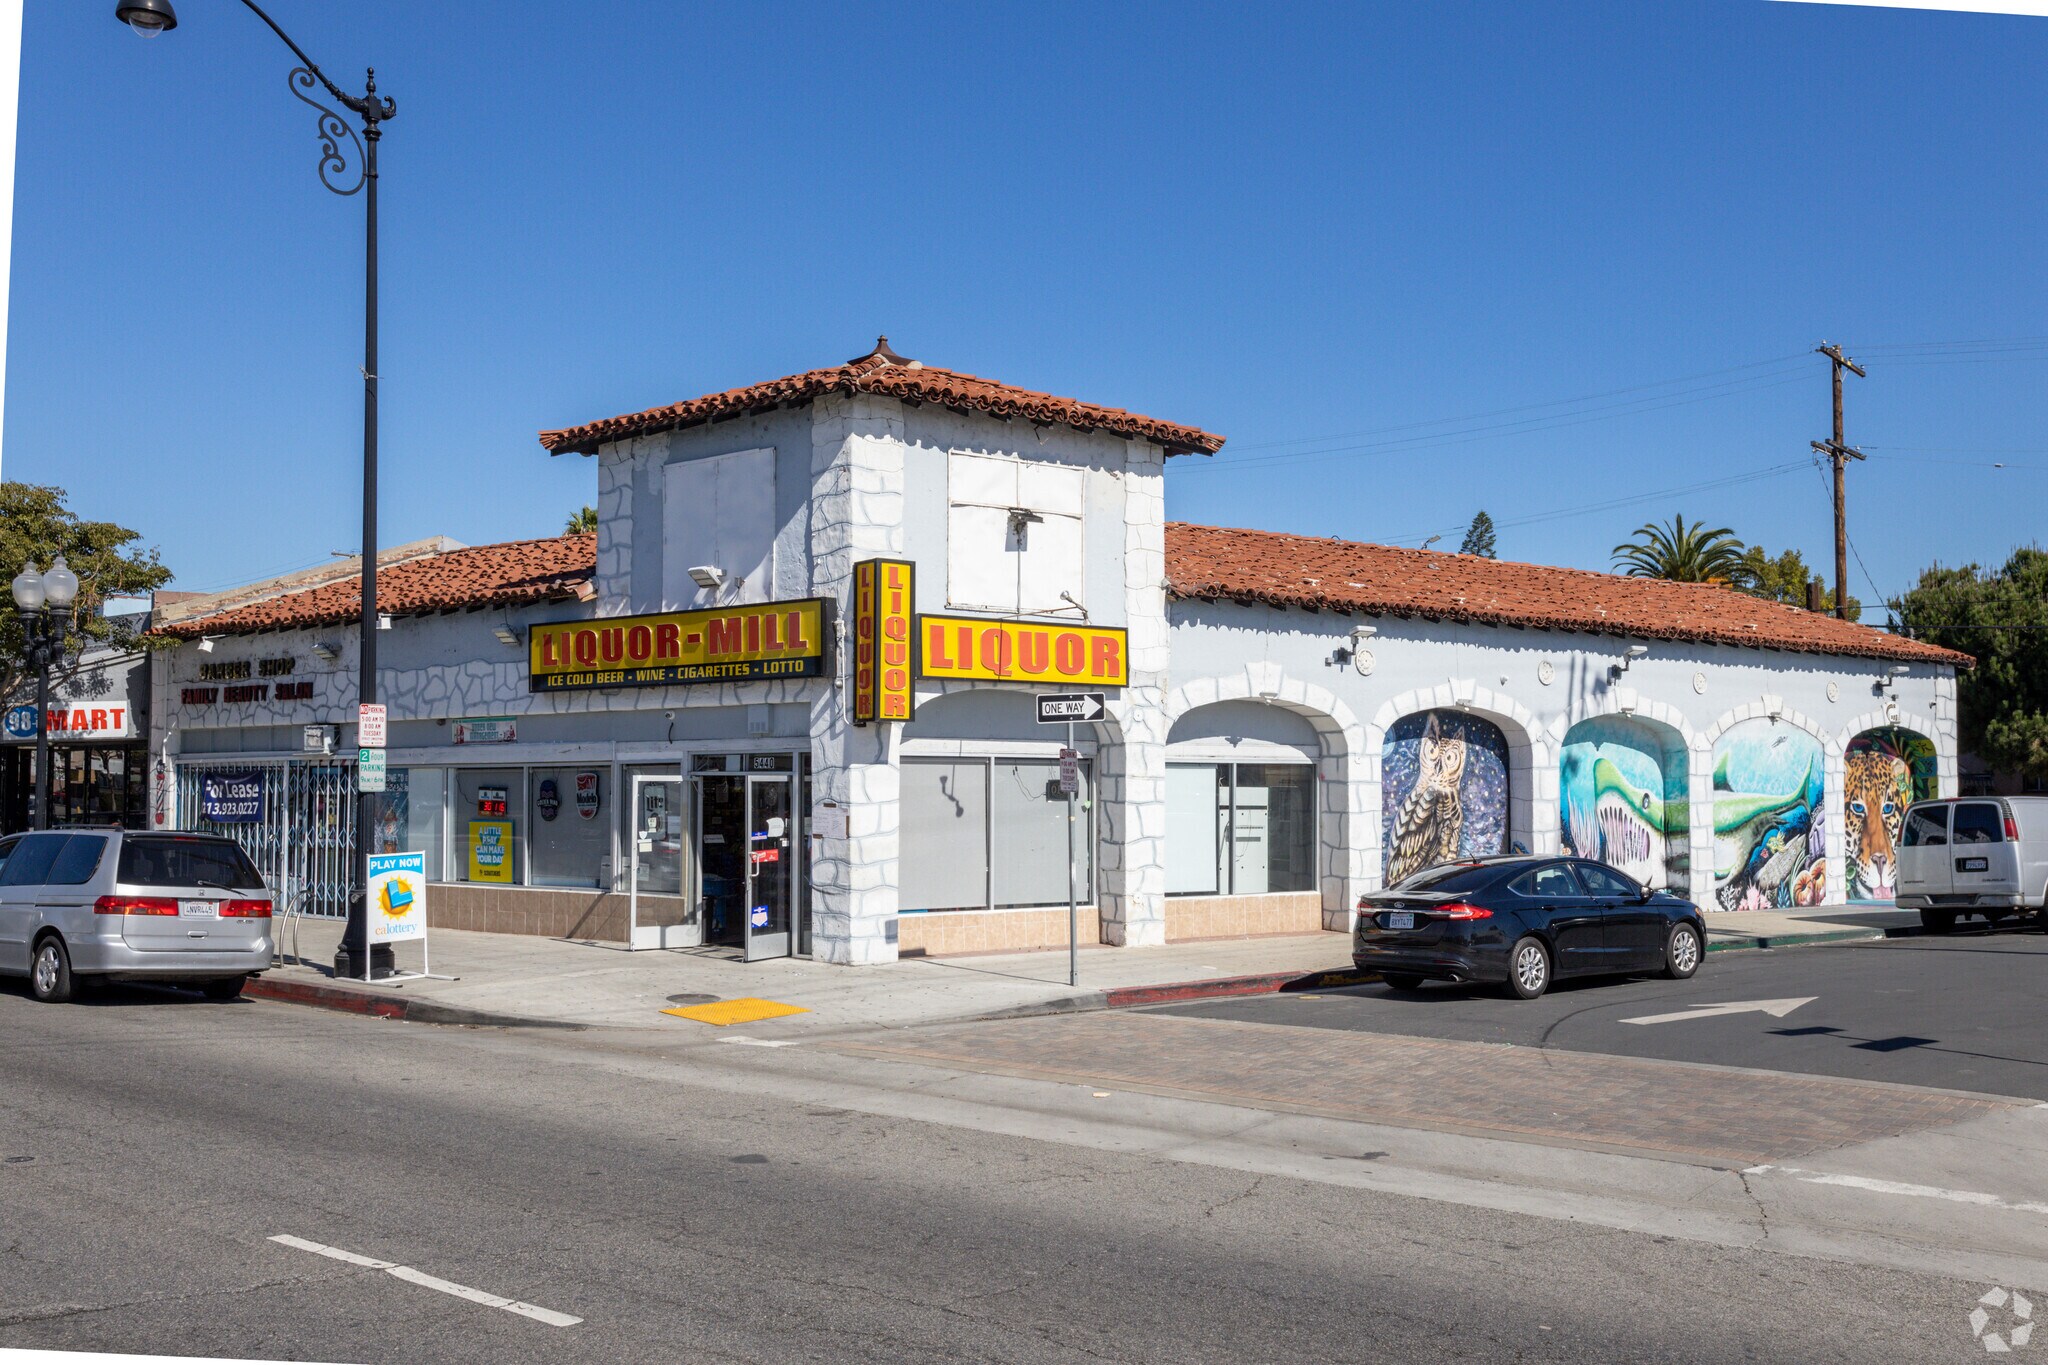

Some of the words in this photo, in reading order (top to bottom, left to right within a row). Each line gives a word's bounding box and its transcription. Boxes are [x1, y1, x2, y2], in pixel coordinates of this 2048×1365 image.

[542, 623, 680, 668] LIQUOR
[708, 611, 808, 655] MILL
[859, 567, 872, 715] LIQUOR
[884, 566, 906, 716] LIQUOR
[929, 624, 1120, 677] LIQUOR
[200, 661, 251, 680] BARBER
[258, 658, 295, 677] SHOP
[547, 675, 564, 687] ICE
[566, 673, 594, 686] COLD
[597, 671, 624, 684] BEER
[636, 668, 665, 681] WINE
[677, 663, 750, 679] CIGARETTES
[763, 660, 804, 674] LOTTO
[181, 688, 219, 704] FAMILY
[224, 685, 268, 702] BEAUTY
[275, 682, 313, 700] SALON
[1044, 703, 1064, 714] ONE
[1066, 702, 1085, 713] WAY
[47, 708, 125, 731] MART
[362, 751, 368, 760] 2
[754, 757, 774, 768] 5440
[360, 764, 384, 772] PARKING
[206, 780, 223, 797] For
[226, 780, 259, 797] Lease
[484, 826, 502, 835] LITTLE
[476, 845, 489, 854] CAN
[489, 846, 505, 854] MAKE
[370, 859, 397, 870] PLAY
[400, 857, 421, 868] NOW
[477, 855, 492, 864] YOUR
[493, 855, 504, 864] DAY
